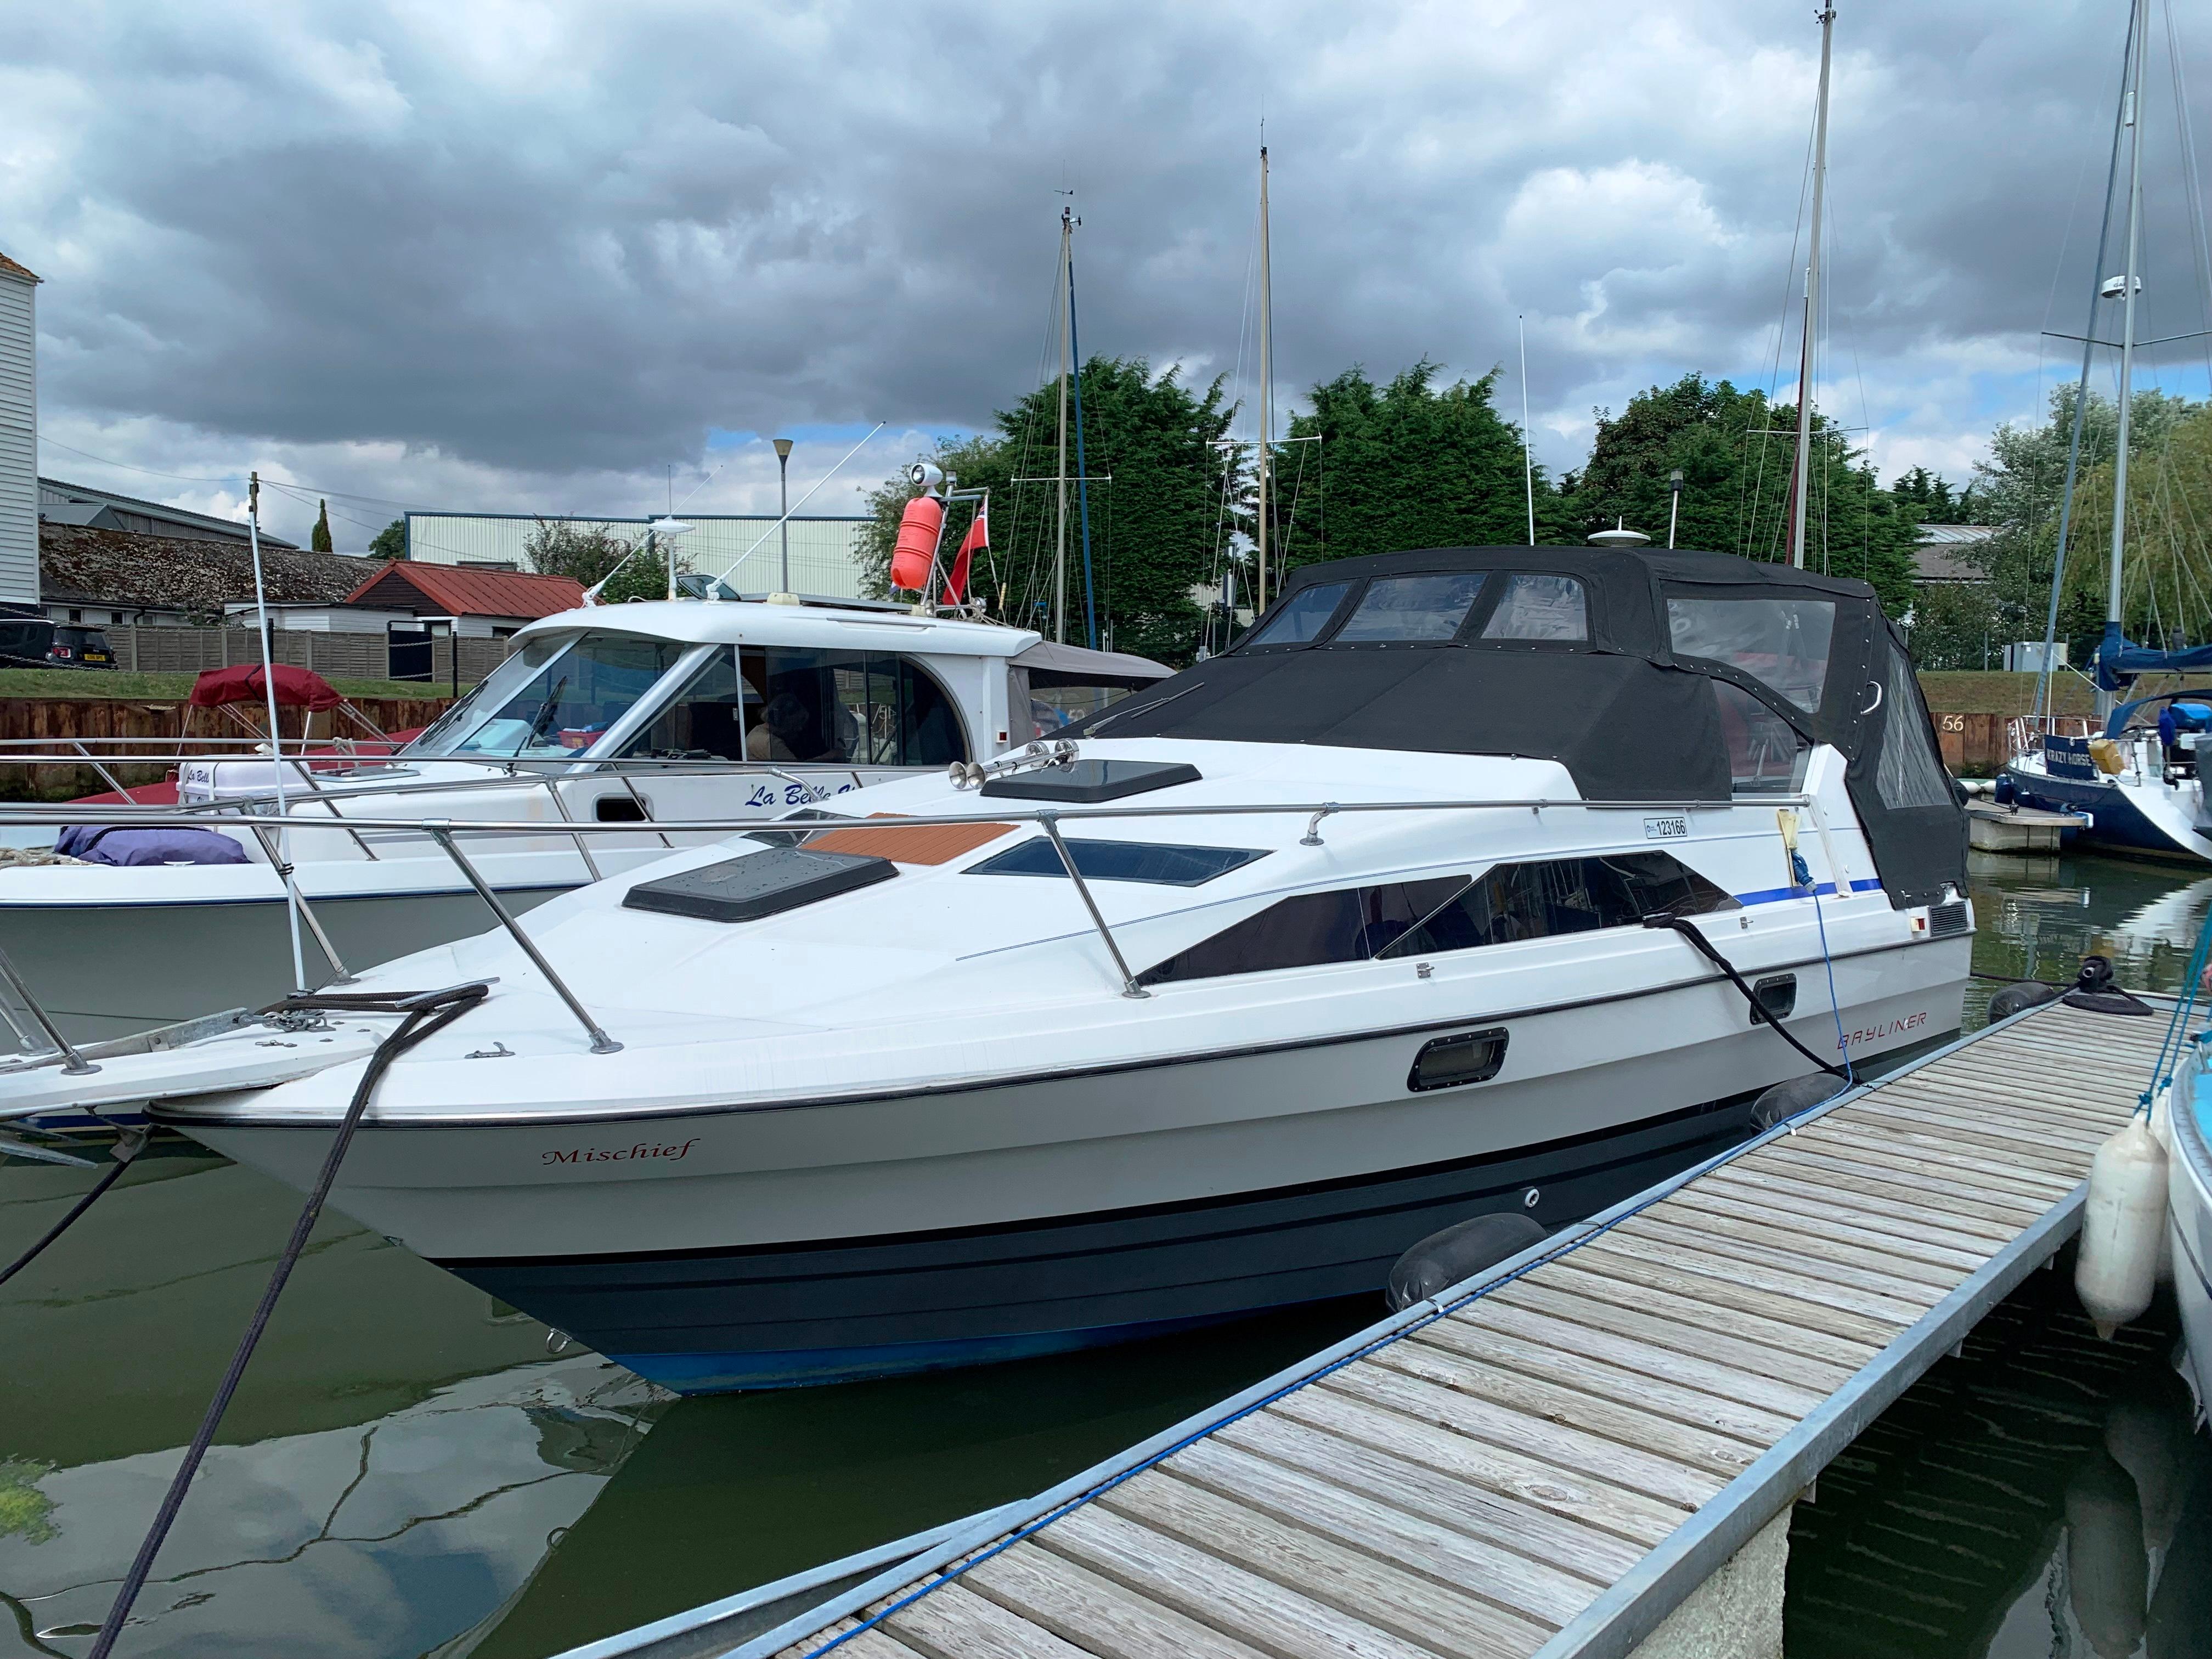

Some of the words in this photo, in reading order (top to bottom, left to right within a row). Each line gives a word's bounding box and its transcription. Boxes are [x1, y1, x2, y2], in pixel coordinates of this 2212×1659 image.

[1943, 715, 1963, 731] 56
[2046, 748, 2067, 764] KRAZY
[2068, 752, 2092, 766] HORSE
[197, 770, 210, 783] Bell
[745, 786, 776, 807] La
[1657, 820, 1685, 835] 123166
[1837, 1012, 1927, 1049] BAYLINER
[542, 1138, 701, 1165] Mischief
